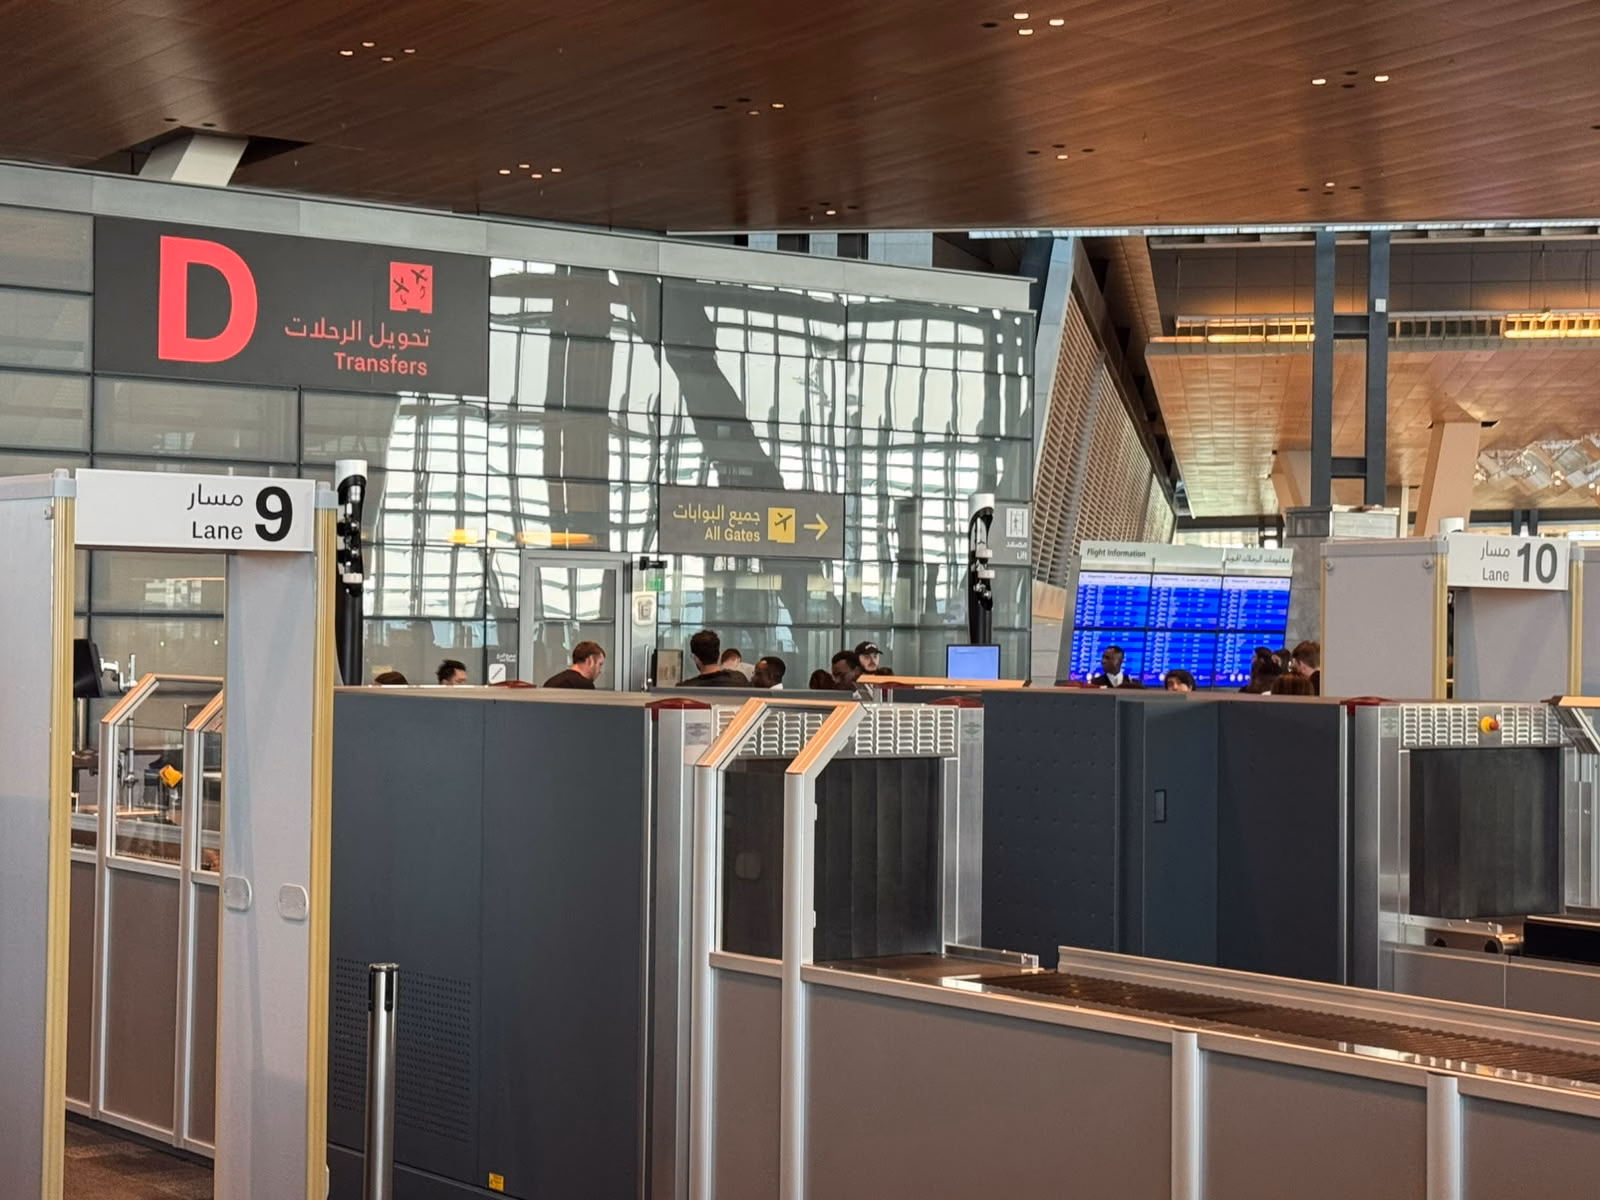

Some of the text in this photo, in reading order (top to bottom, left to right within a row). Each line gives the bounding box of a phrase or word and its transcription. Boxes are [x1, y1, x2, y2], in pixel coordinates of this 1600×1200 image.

[158, 235, 258, 363] D
[284, 317, 430, 350] تحويل الرحلات
[334, 352, 428, 376] Transfers
[187, 483, 244, 510] مسار
[255, 486, 293, 542] 9
[672, 503, 760, 528] جميع البوابات
[192, 521, 243, 540] Lane
[704, 526, 760, 542] All Gates
[1016, 550, 1027, 560] Lift
[1087, 548, 1146, 558] Flight Information
[1480, 540, 1510, 560] مسار
[1482, 568, 1510, 581] Lane
[1517, 542, 1558, 584] 10
